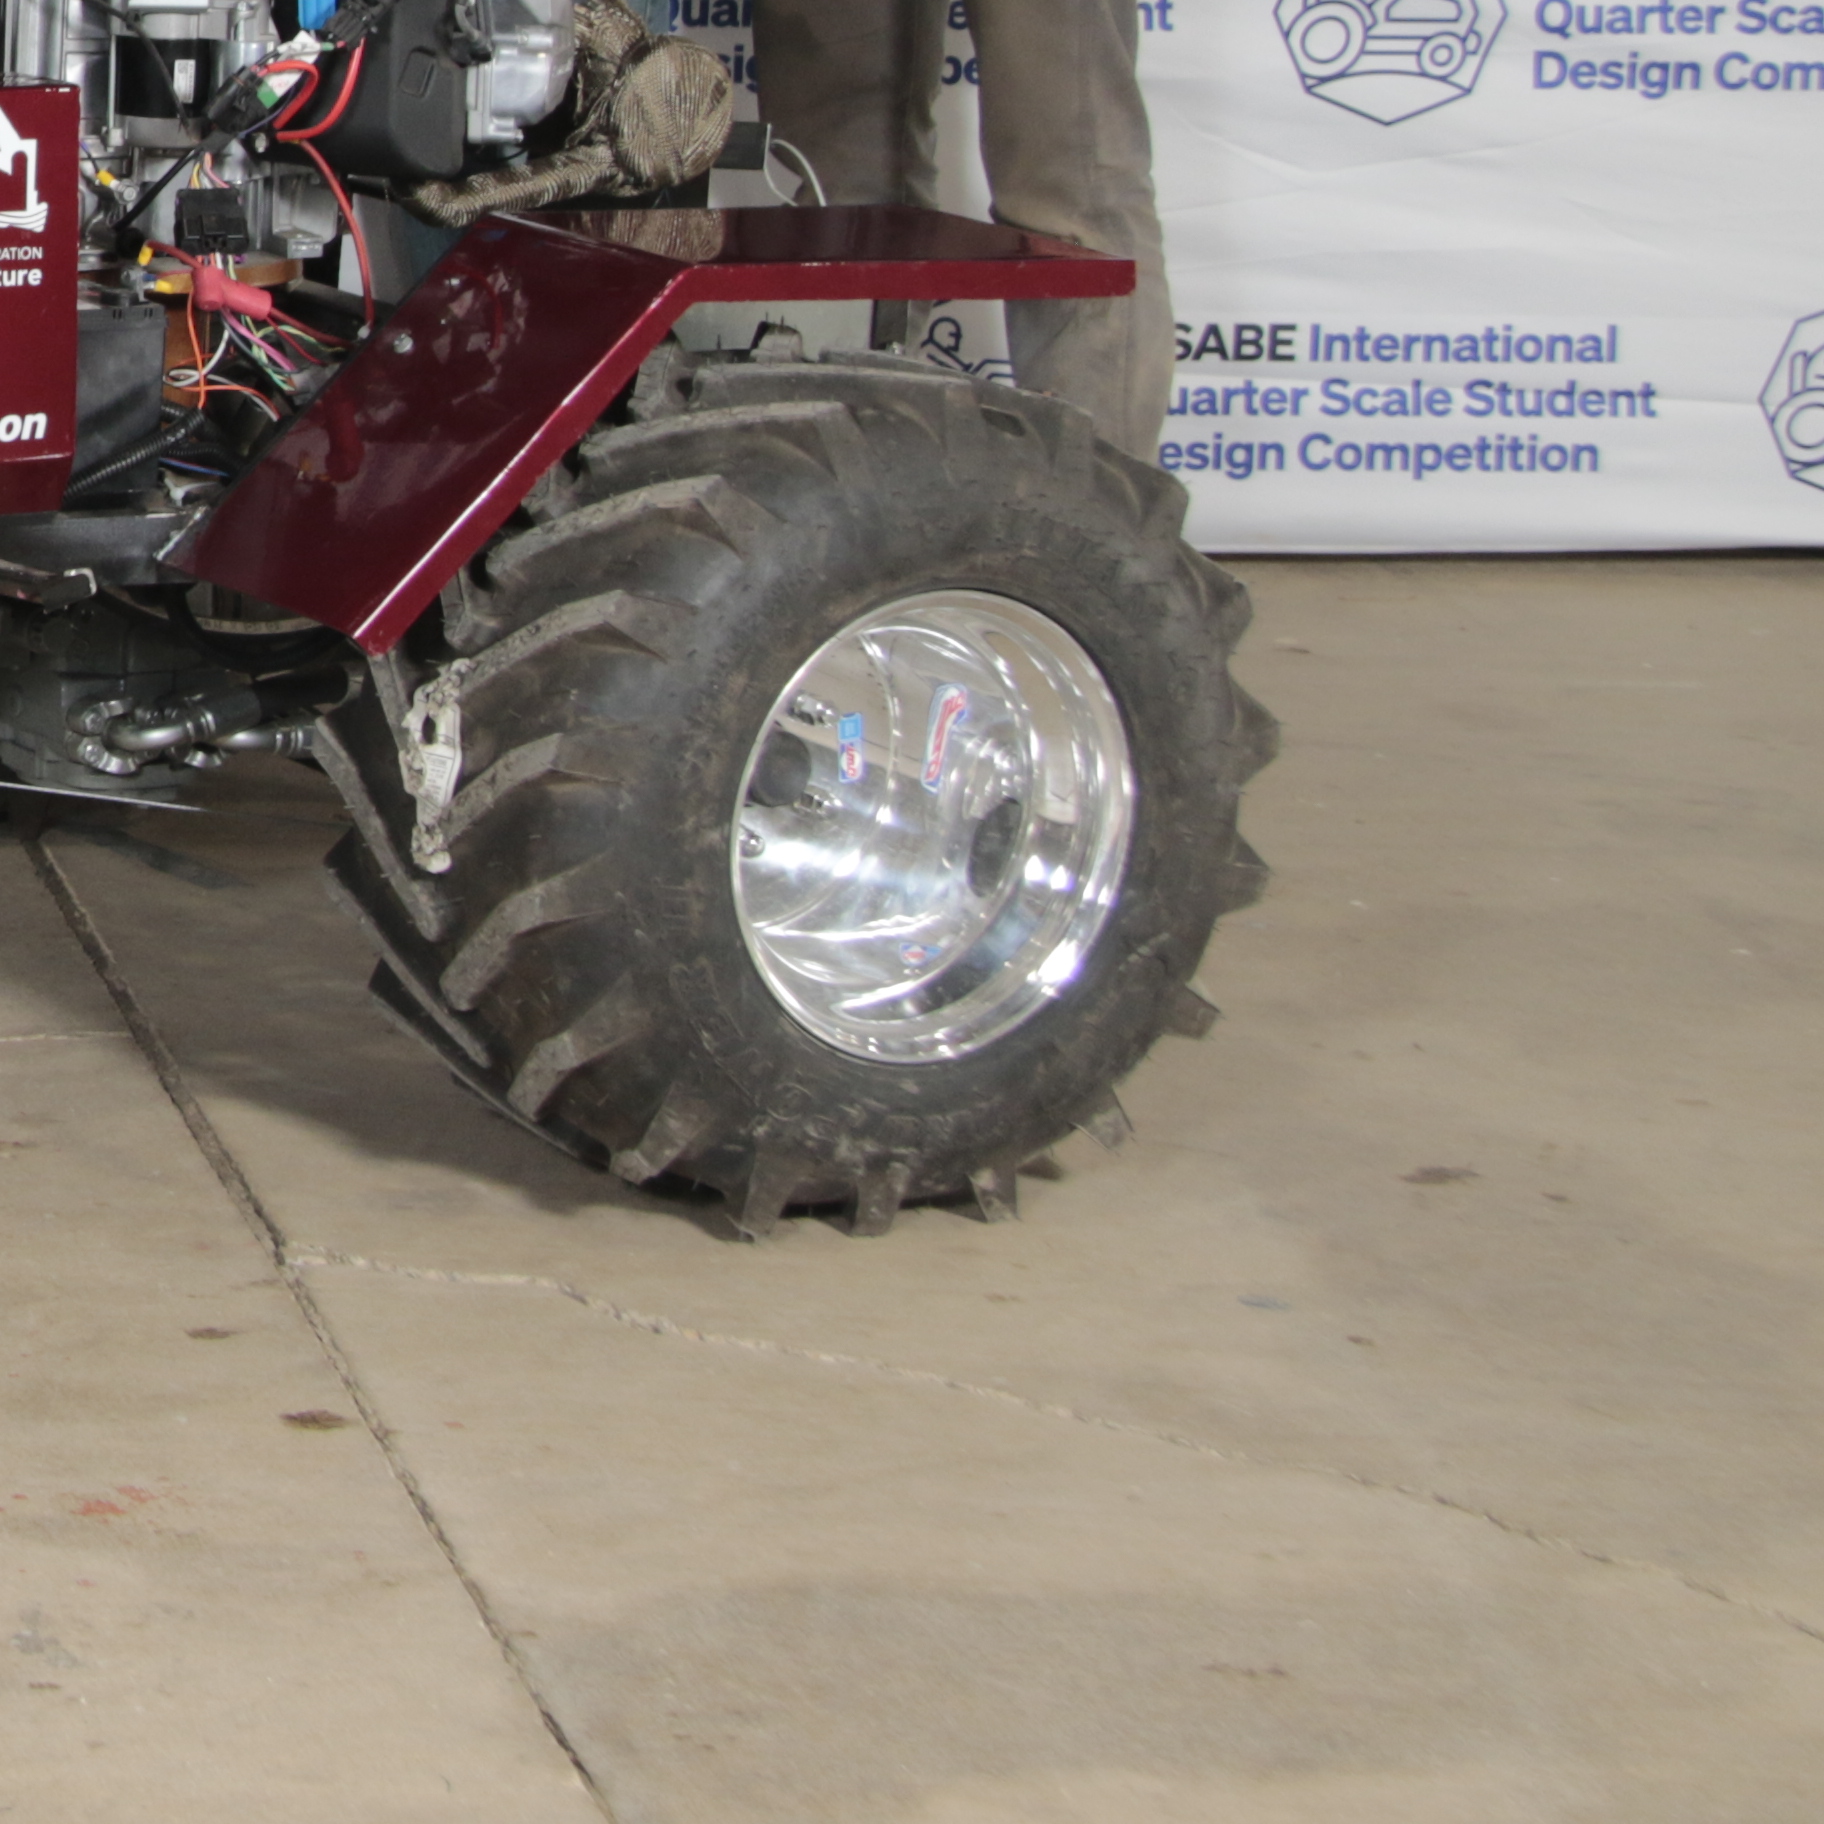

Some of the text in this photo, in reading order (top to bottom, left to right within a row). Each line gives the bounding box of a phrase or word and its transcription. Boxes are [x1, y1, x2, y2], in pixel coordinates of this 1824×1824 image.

[1175, 323, 1616, 363] SABE International
[1167, 378, 1657, 417] uarter Scale Student
[1158, 432, 1598, 480] esign Competition
